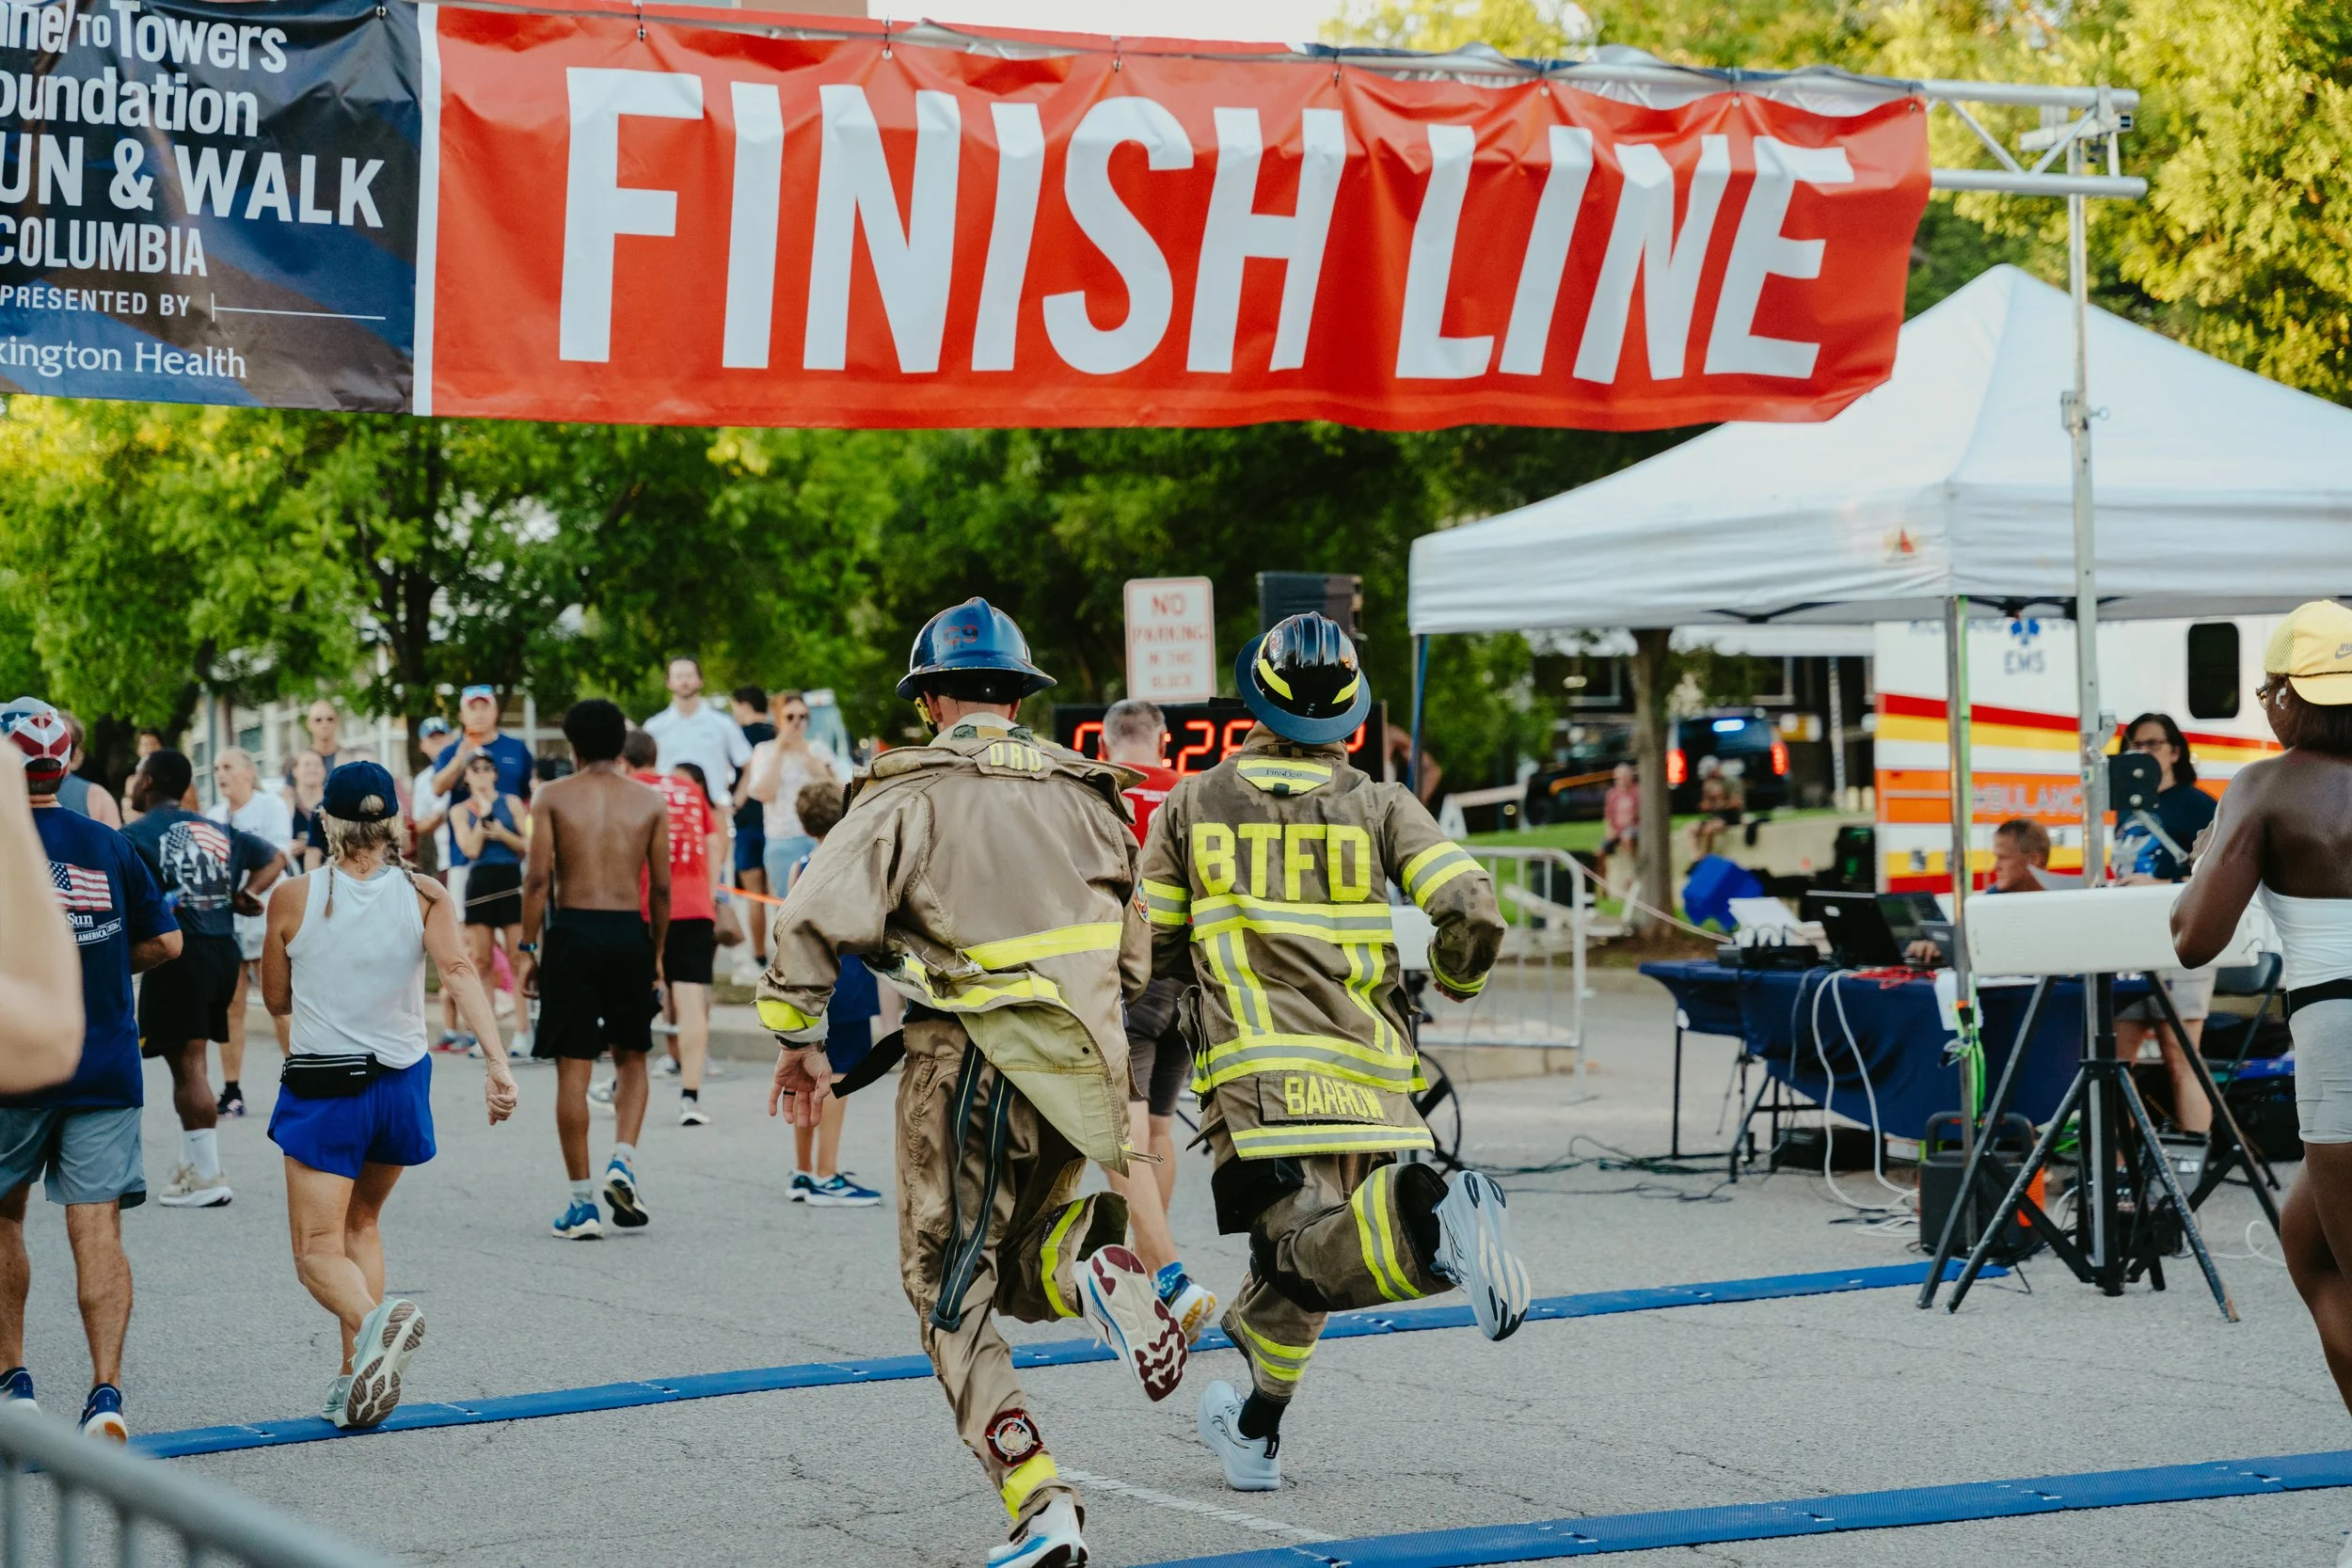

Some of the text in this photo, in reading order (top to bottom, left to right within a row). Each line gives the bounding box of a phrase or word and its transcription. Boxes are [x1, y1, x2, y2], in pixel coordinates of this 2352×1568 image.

[77, 13, 111, 48] TO
[110, 0, 287, 73] Towers
[109, 138, 153, 212] &
[174, 145, 385, 228] WALK
[0, 214, 208, 277] COLUMBIA
[560, 66, 1854, 384] FINISH LINE
[0, 285, 191, 317] PRESENTED BY
[135, 341, 246, 379] Health
[1151, 593, 1187, 617] NO
[1133, 624, 1208, 645] PARKING
[2005, 650, 2044, 675] EMS
[1192, 822, 1372, 903] BTFD
[78, 928, 108, 942] AMERICA
[1284, 1075, 1386, 1120] BARROW
